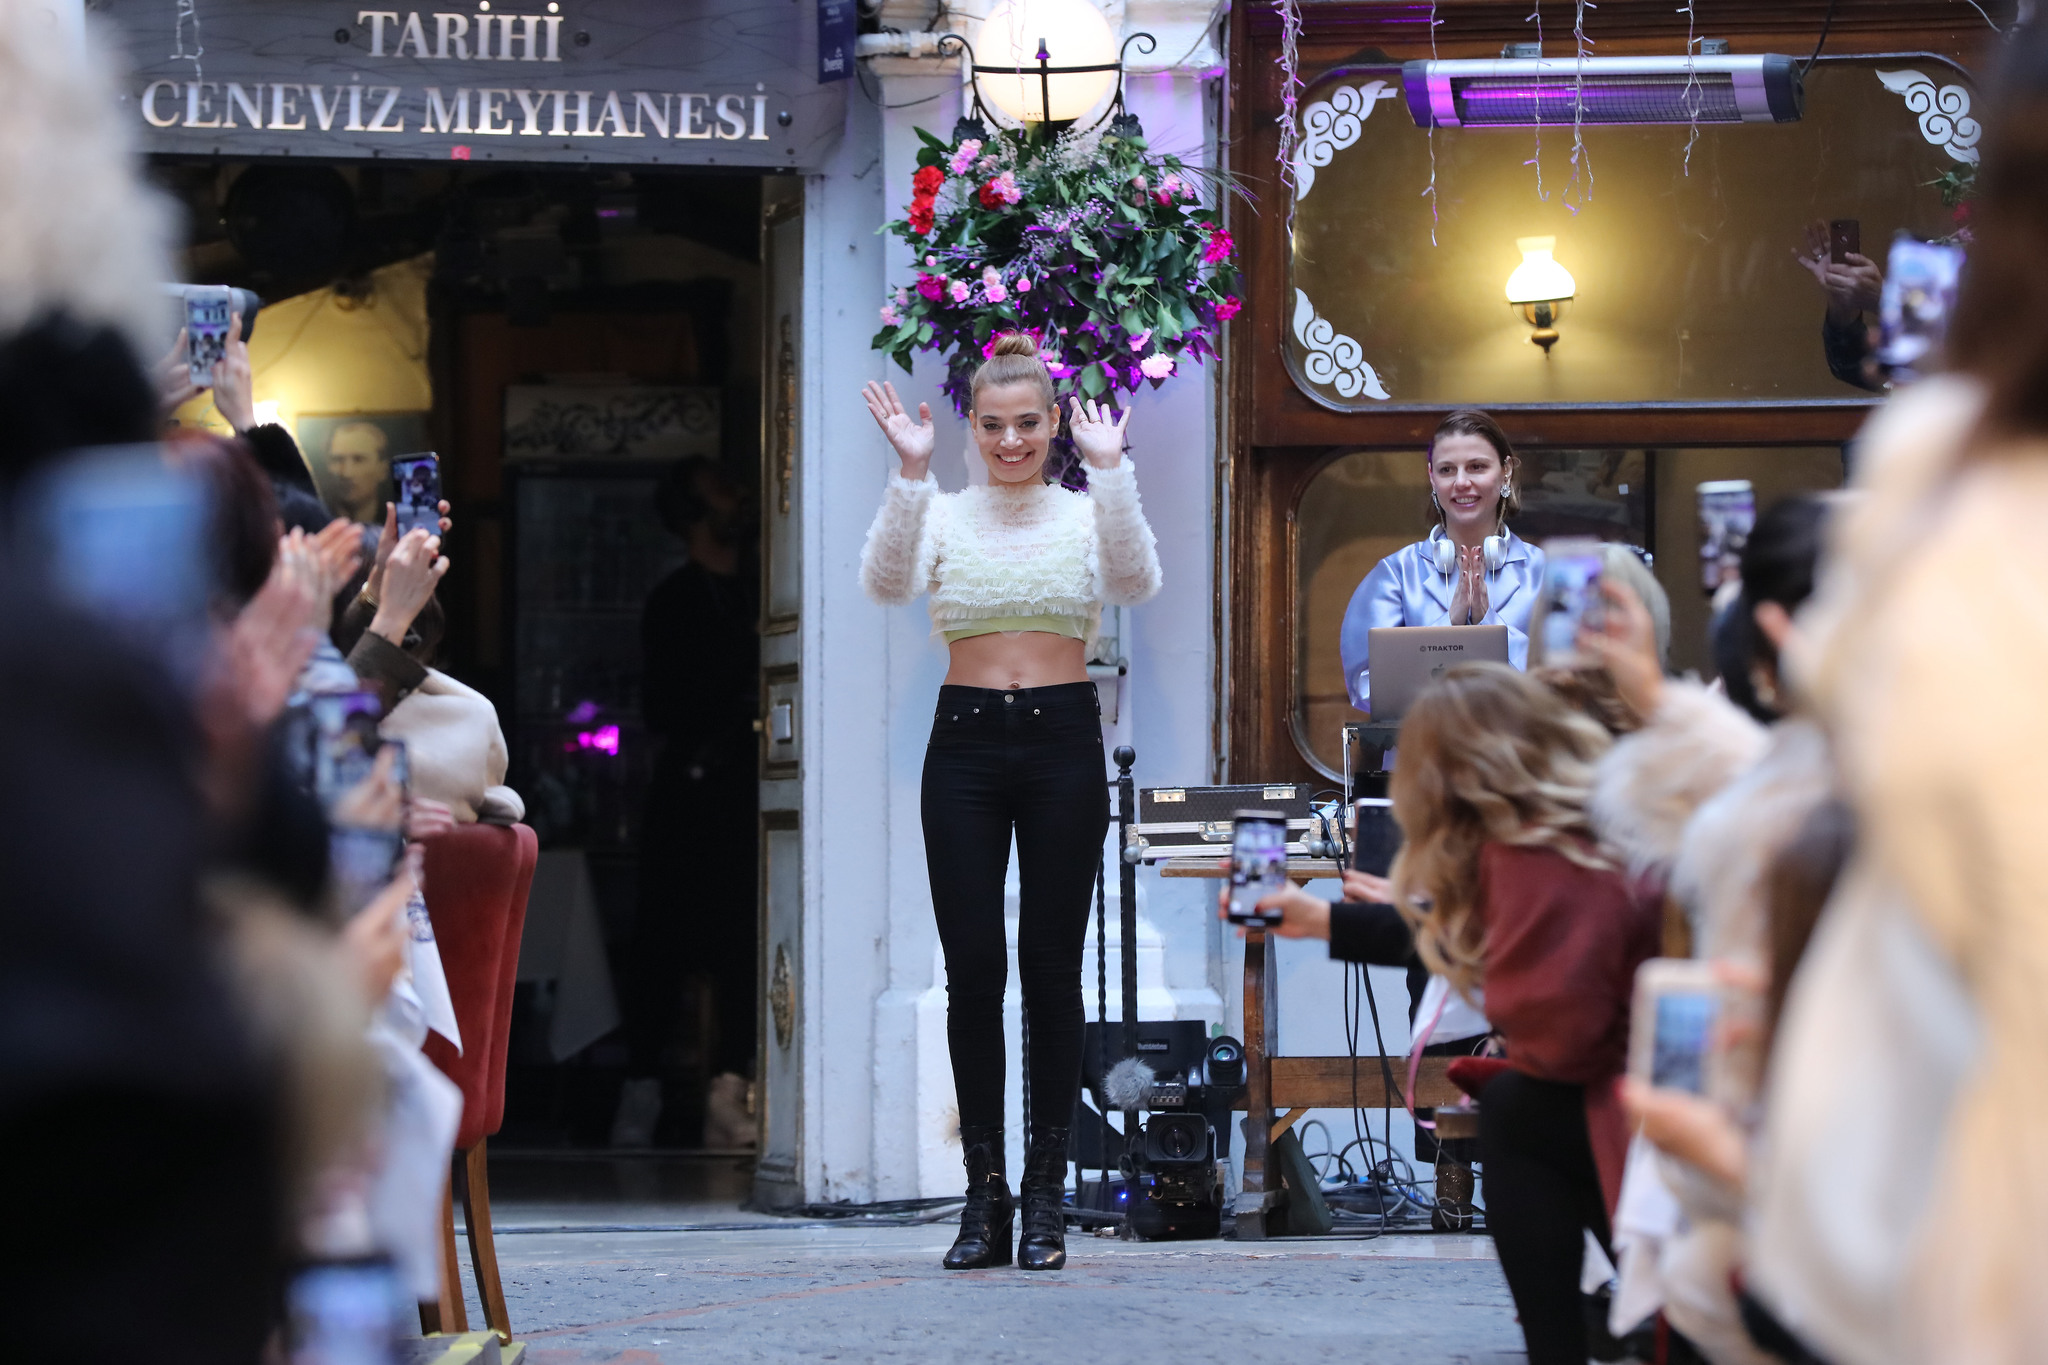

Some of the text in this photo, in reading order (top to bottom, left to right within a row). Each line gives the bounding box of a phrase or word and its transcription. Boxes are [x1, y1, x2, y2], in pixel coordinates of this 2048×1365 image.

[357, 1, 564, 61] TARİHİ
[141, 72, 769, 140] CENEVİZ MEYHANESİ
